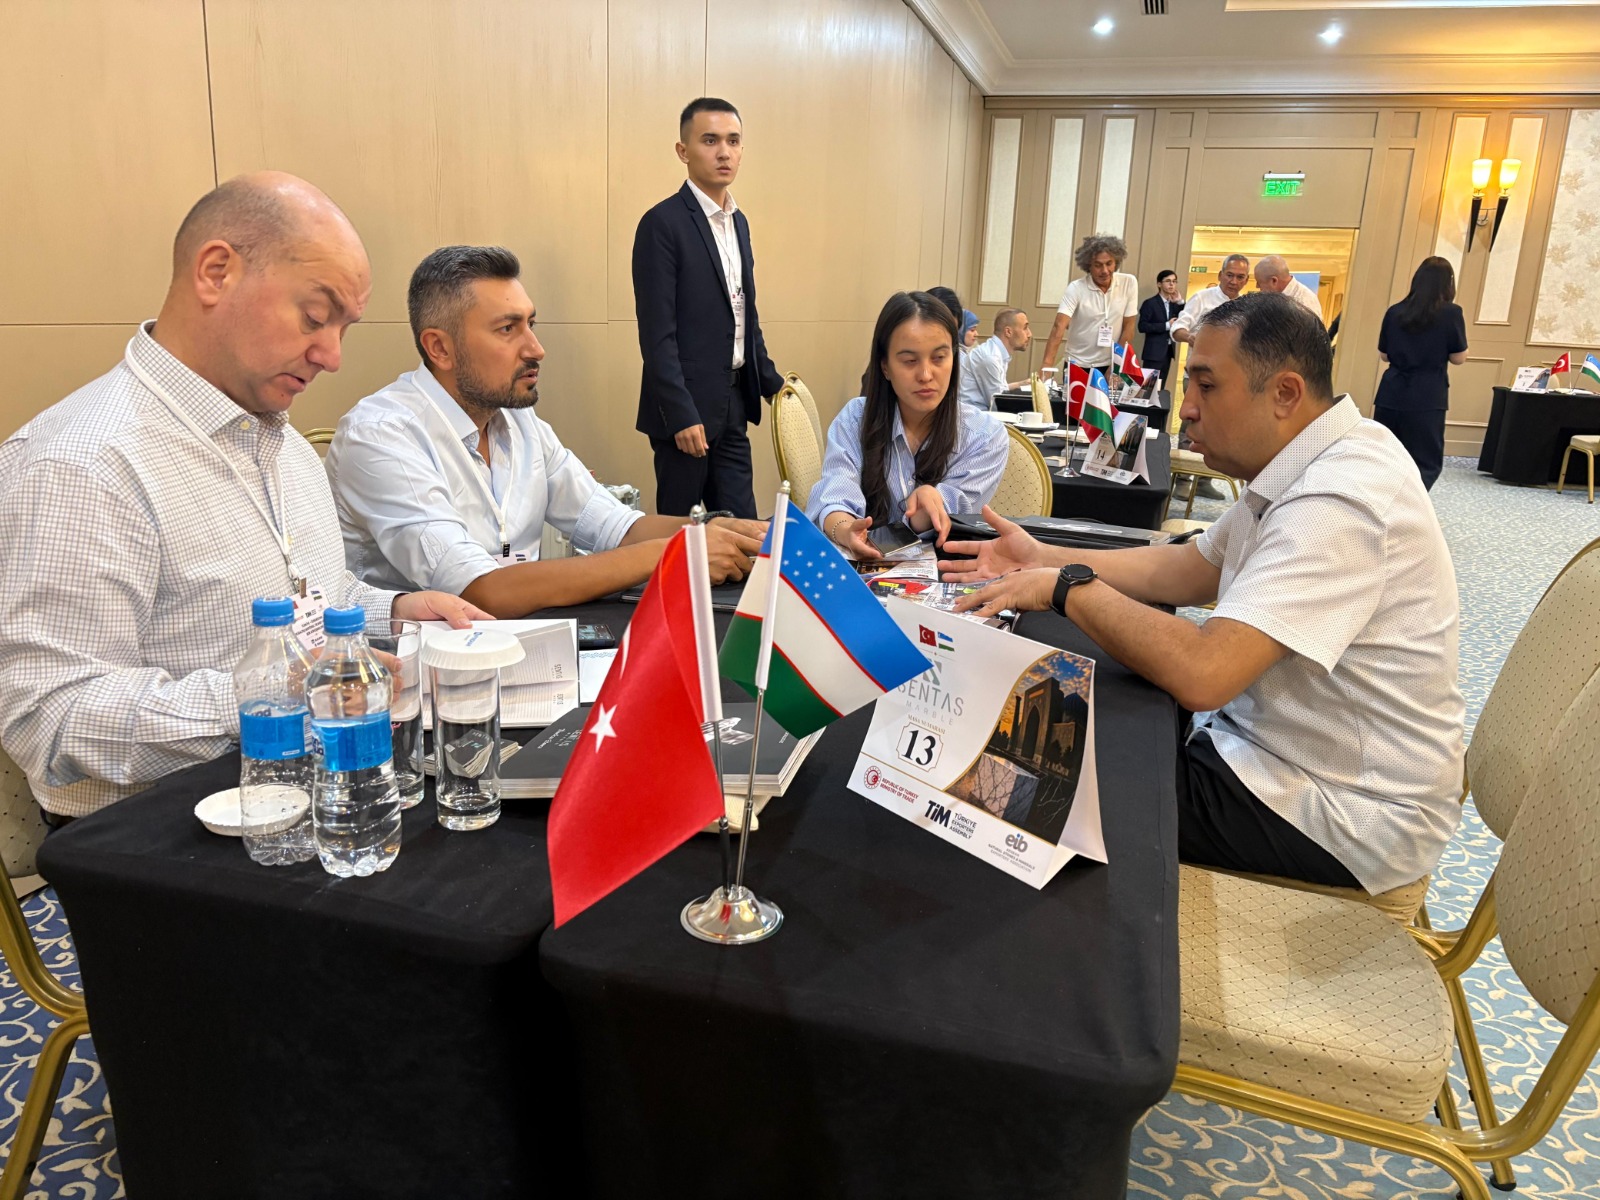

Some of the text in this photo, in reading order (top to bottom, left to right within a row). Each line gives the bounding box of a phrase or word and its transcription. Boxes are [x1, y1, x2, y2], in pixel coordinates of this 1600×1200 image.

[1265, 181, 1300, 195] EXIT
[906, 700, 954, 726] MARBLE
[901, 729, 937, 766] 13
[880, 783, 897, 796] MINISTRY
[902, 793, 915, 804] TRADE
[882, 777, 900, 790] REPUBLIC
[904, 789, 919, 800] TURKEY
[949, 825, 972, 840] ASSEMBLY
